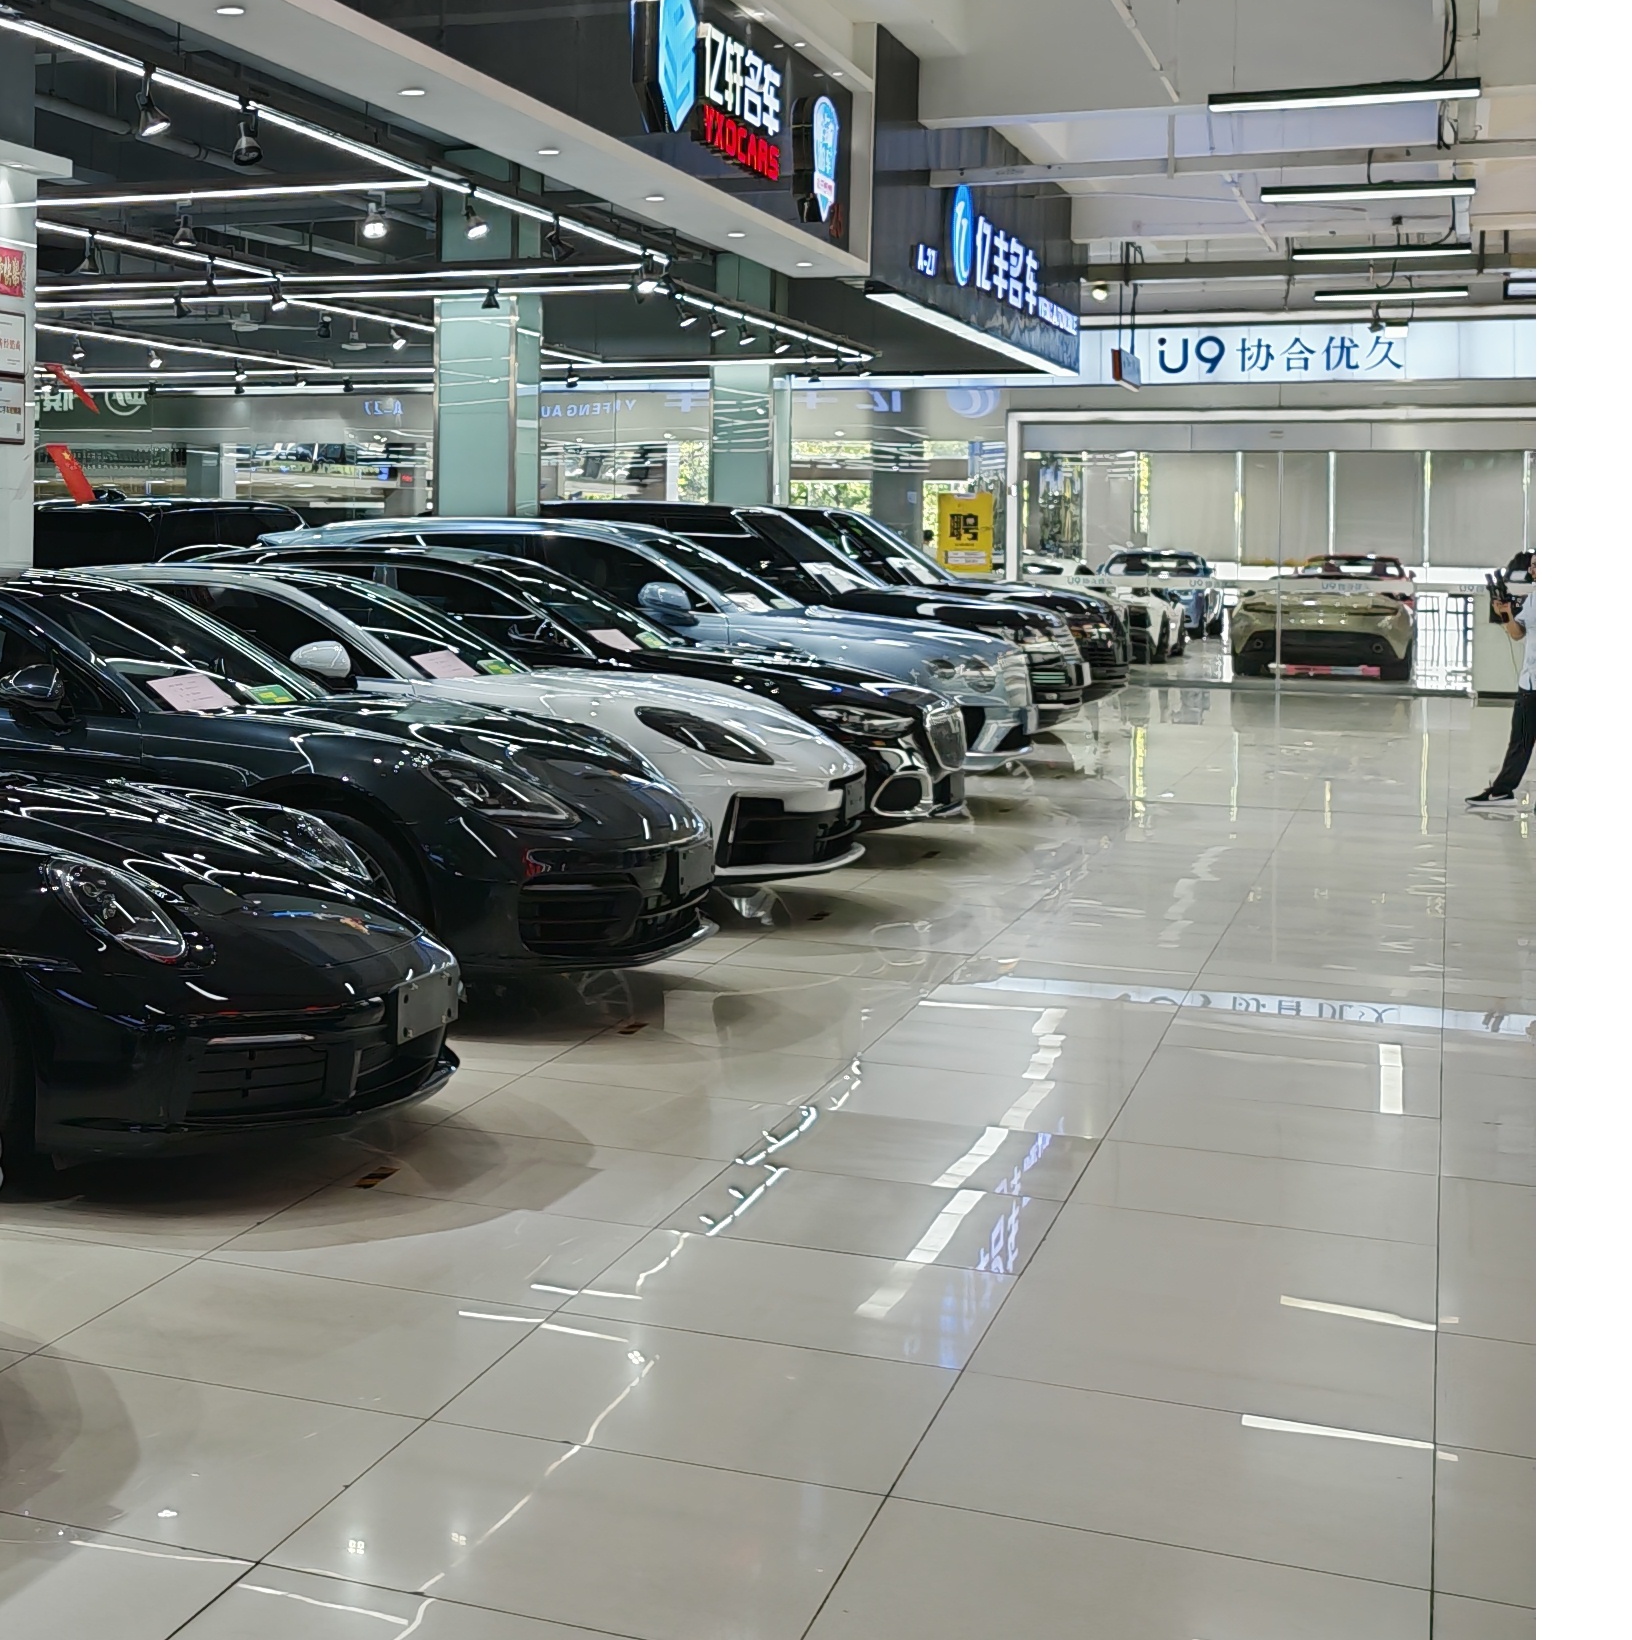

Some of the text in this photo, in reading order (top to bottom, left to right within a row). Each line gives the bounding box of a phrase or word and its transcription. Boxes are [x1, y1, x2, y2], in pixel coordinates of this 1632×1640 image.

[702, 23, 781, 136] 亿轩名车
[703, 104, 781, 182] YXOCARS
[975, 215, 1040, 315] 亿丰名车
[1236, 336, 1403, 372] 协合优久
[949, 513, 979, 541] 聘
